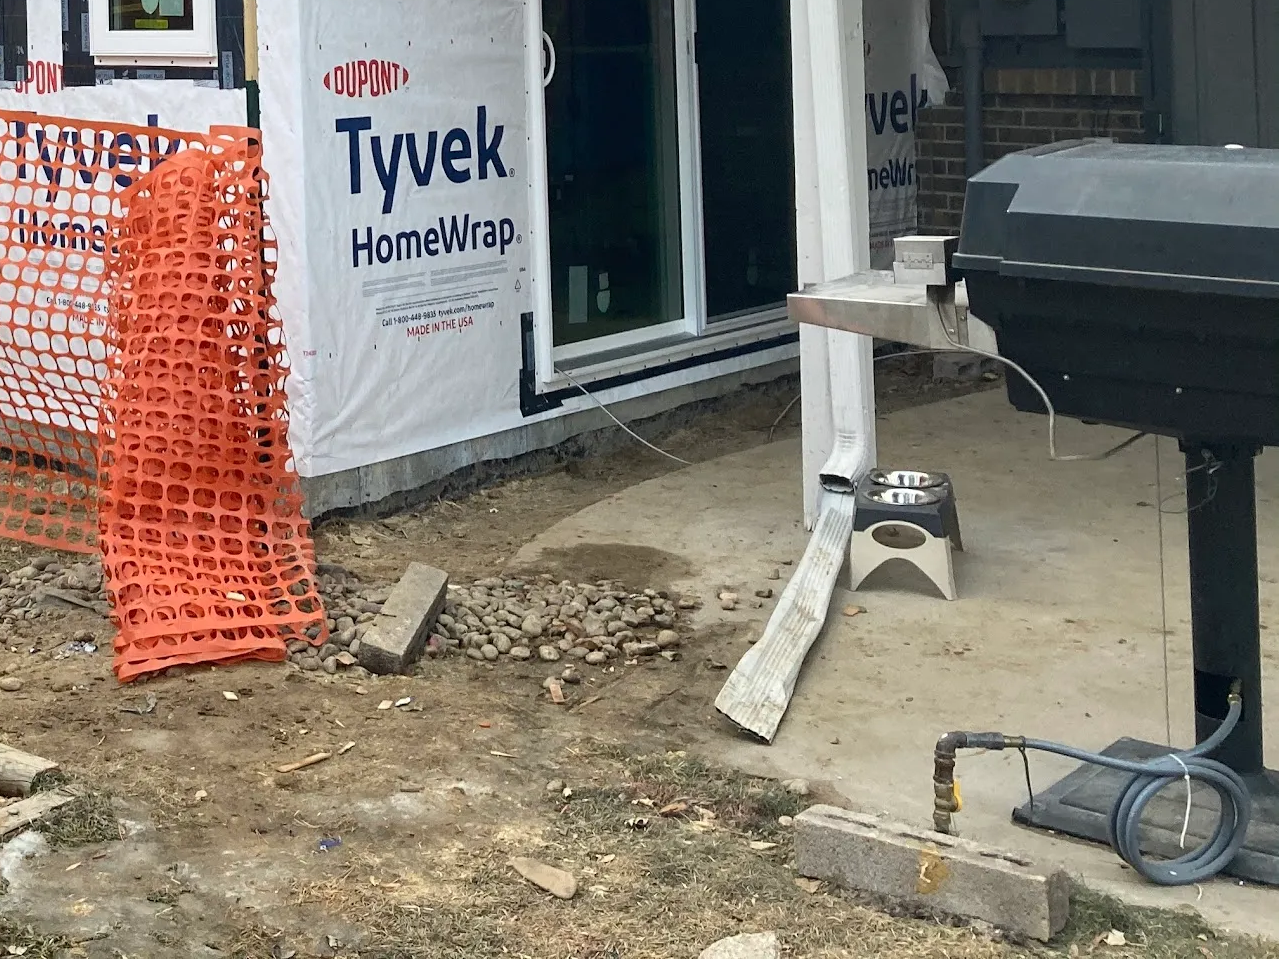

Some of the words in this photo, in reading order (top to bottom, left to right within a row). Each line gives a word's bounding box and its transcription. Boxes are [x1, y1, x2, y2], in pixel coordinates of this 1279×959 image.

[334, 59, 401, 98] DUPONT
[865, 73, 928, 135] vek
[335, 105, 508, 214] Tyvek
[19, 209, 121, 254] Home
[352, 213, 515, 268] HomeWrap
[381, 317, 393, 327] Call
[393, 310, 436, 325] 1-800-448-9835
[438, 301, 495, 318] tyvek.com/homewrap
[407, 323, 430, 338] MADE
[432, 322, 440, 333] IN
[441, 319, 457, 332] THE
[458, 316, 473, 328] USA
